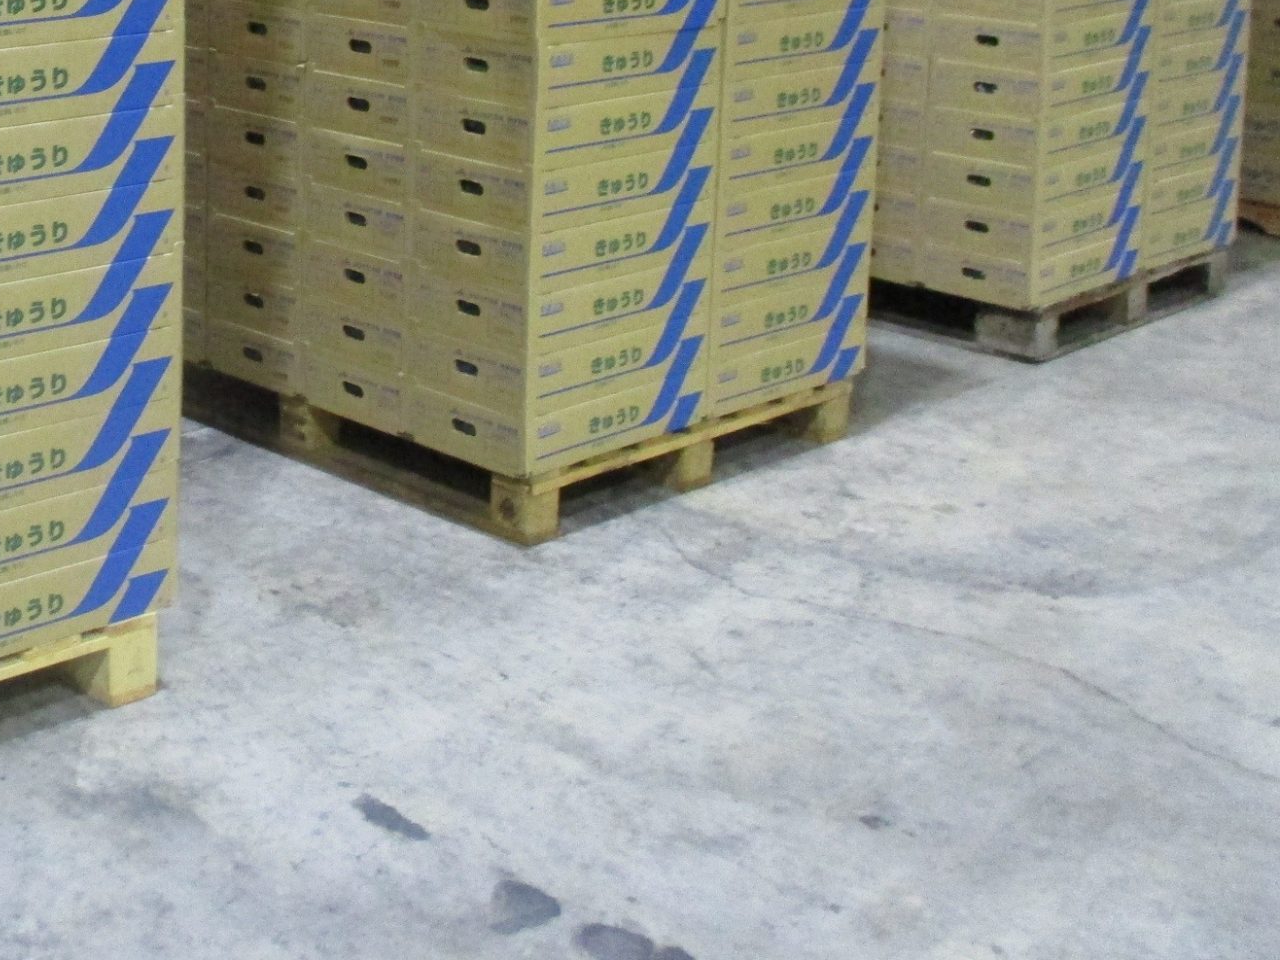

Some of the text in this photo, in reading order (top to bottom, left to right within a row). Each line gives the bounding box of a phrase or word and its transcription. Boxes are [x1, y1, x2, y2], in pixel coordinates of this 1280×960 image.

[601, 50, 654, 74] きゅうり
[599, 110, 652, 135] きゅうり
[597, 170, 649, 197] きゅうり
[594, 231, 647, 258] きゅうり
[592, 288, 644, 315] きゅうり
[590, 345, 642, 375] きゅうり
[588, 404, 640, 434] きゅうり
